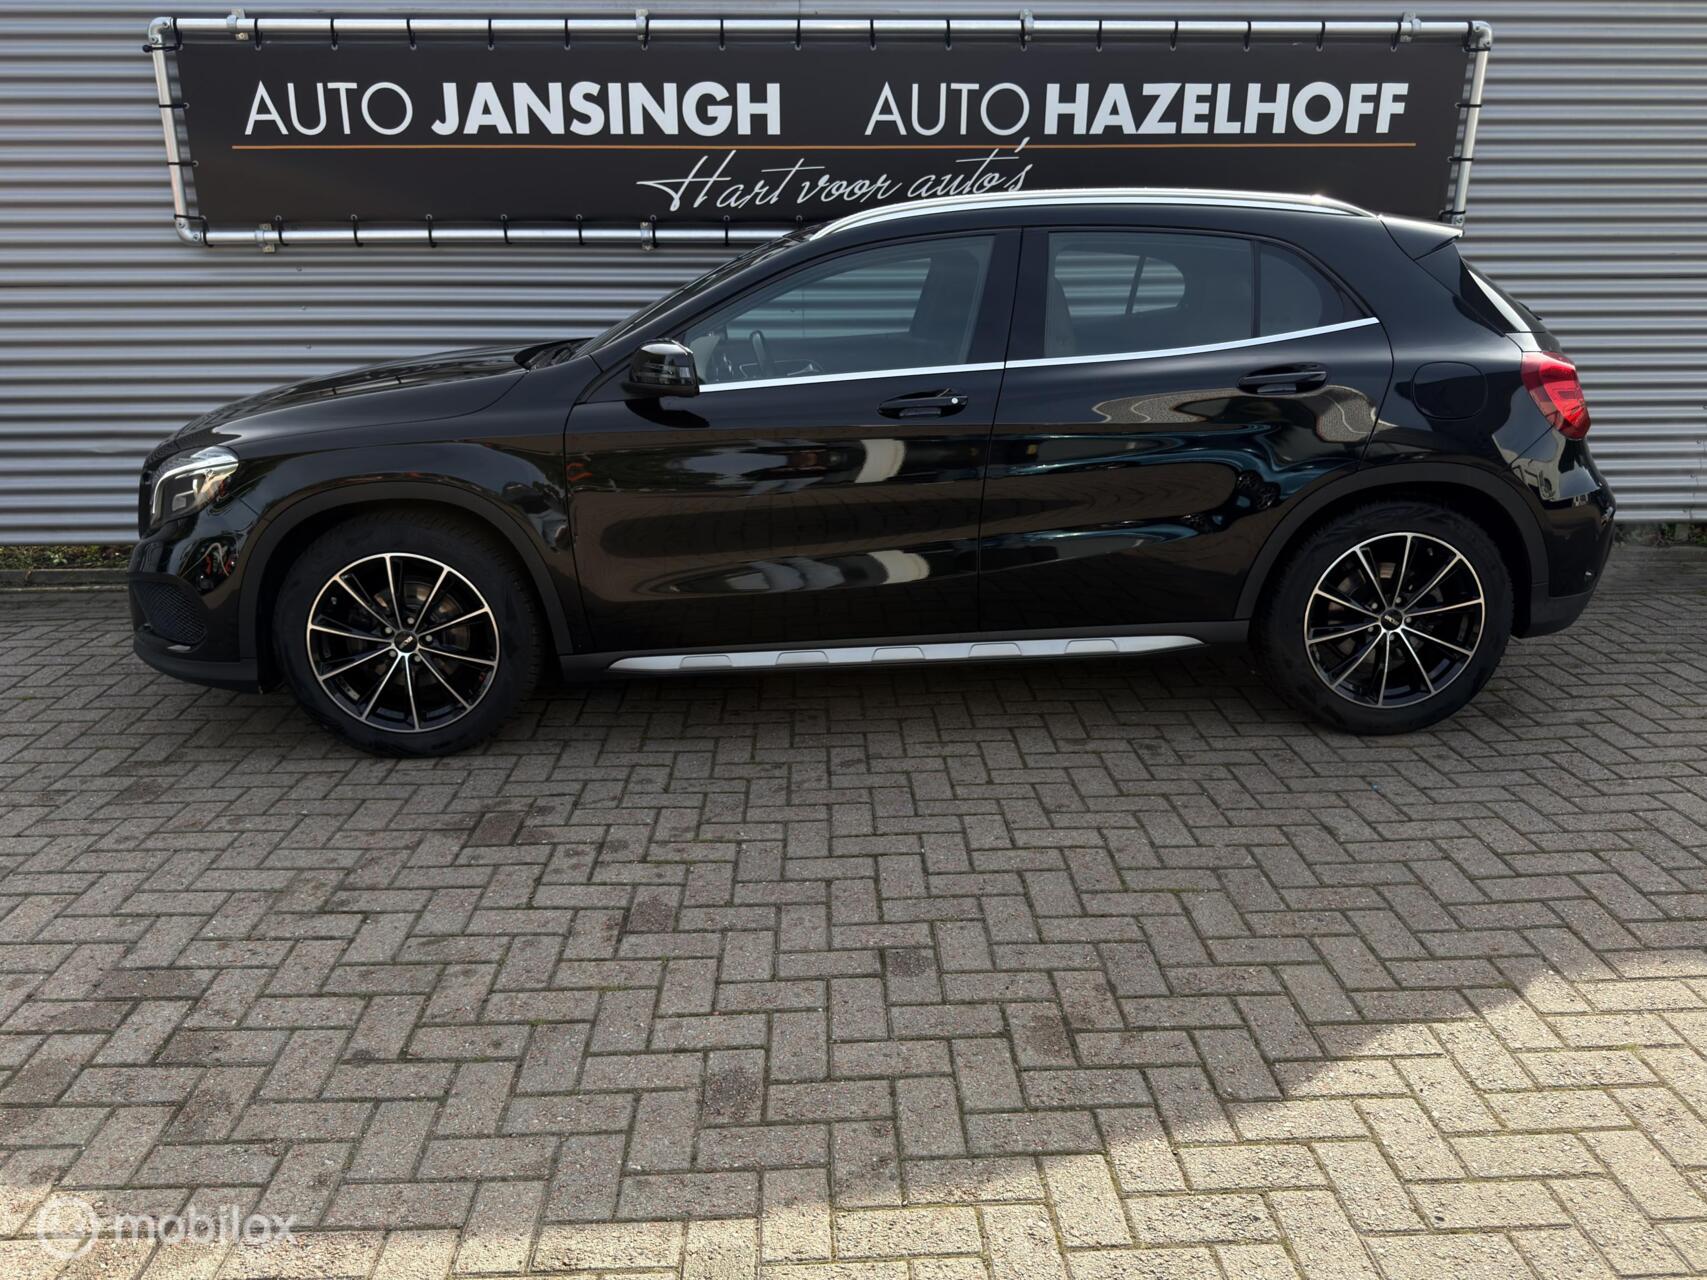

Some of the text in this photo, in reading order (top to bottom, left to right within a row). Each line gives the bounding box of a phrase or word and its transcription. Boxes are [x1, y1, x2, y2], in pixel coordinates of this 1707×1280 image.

[244, 80, 781, 137] AUTO JANSINGH
[864, 80, 1409, 136] AUTO HAZELHOFF
[636, 149, 825, 212] Hart
[797, 173, 903, 204] voor
